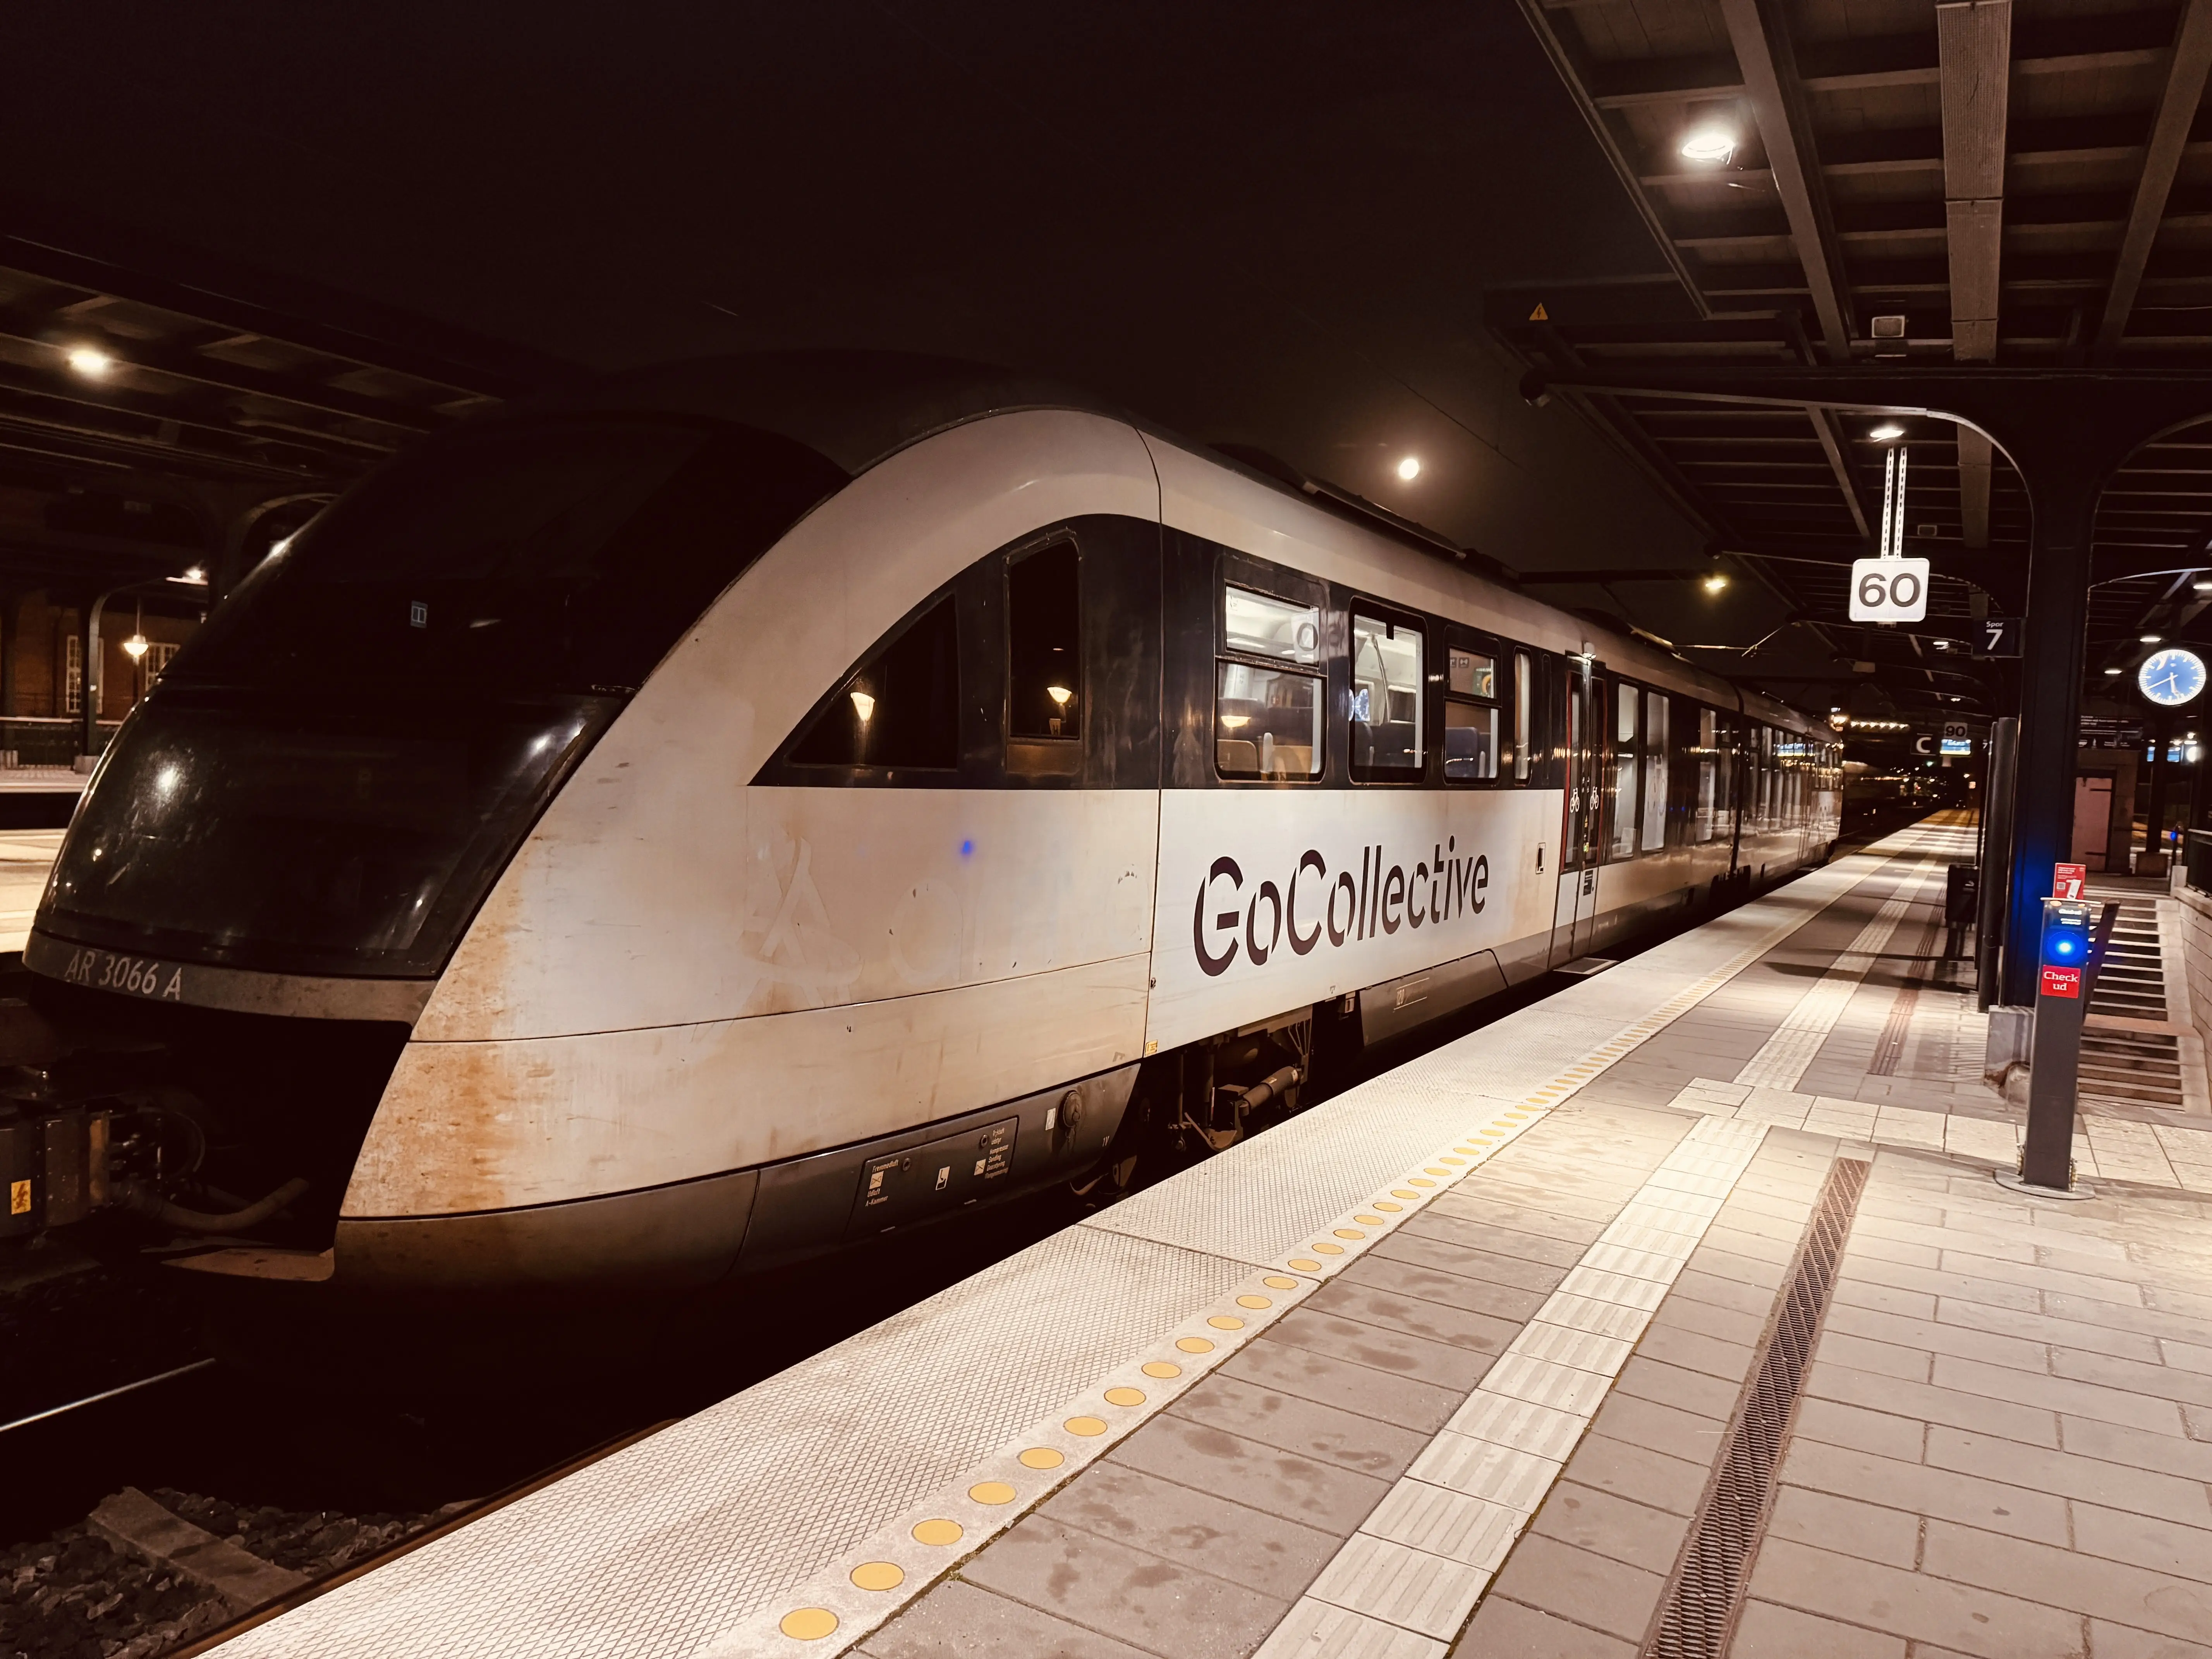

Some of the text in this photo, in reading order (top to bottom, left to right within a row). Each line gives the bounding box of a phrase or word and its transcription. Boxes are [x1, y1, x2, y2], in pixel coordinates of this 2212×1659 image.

[1859, 573, 1920, 607] 60
[1986, 629, 2003, 650] 7
[1946, 725, 1966, 737] 90
[1916, 737, 1932, 753] C
[1194, 835, 1488, 976] GoCollective
[64, 950, 182, 1000] AR 3066 A
[2044, 971, 2079, 982] Check
[2053, 983, 2067, 991] ud
